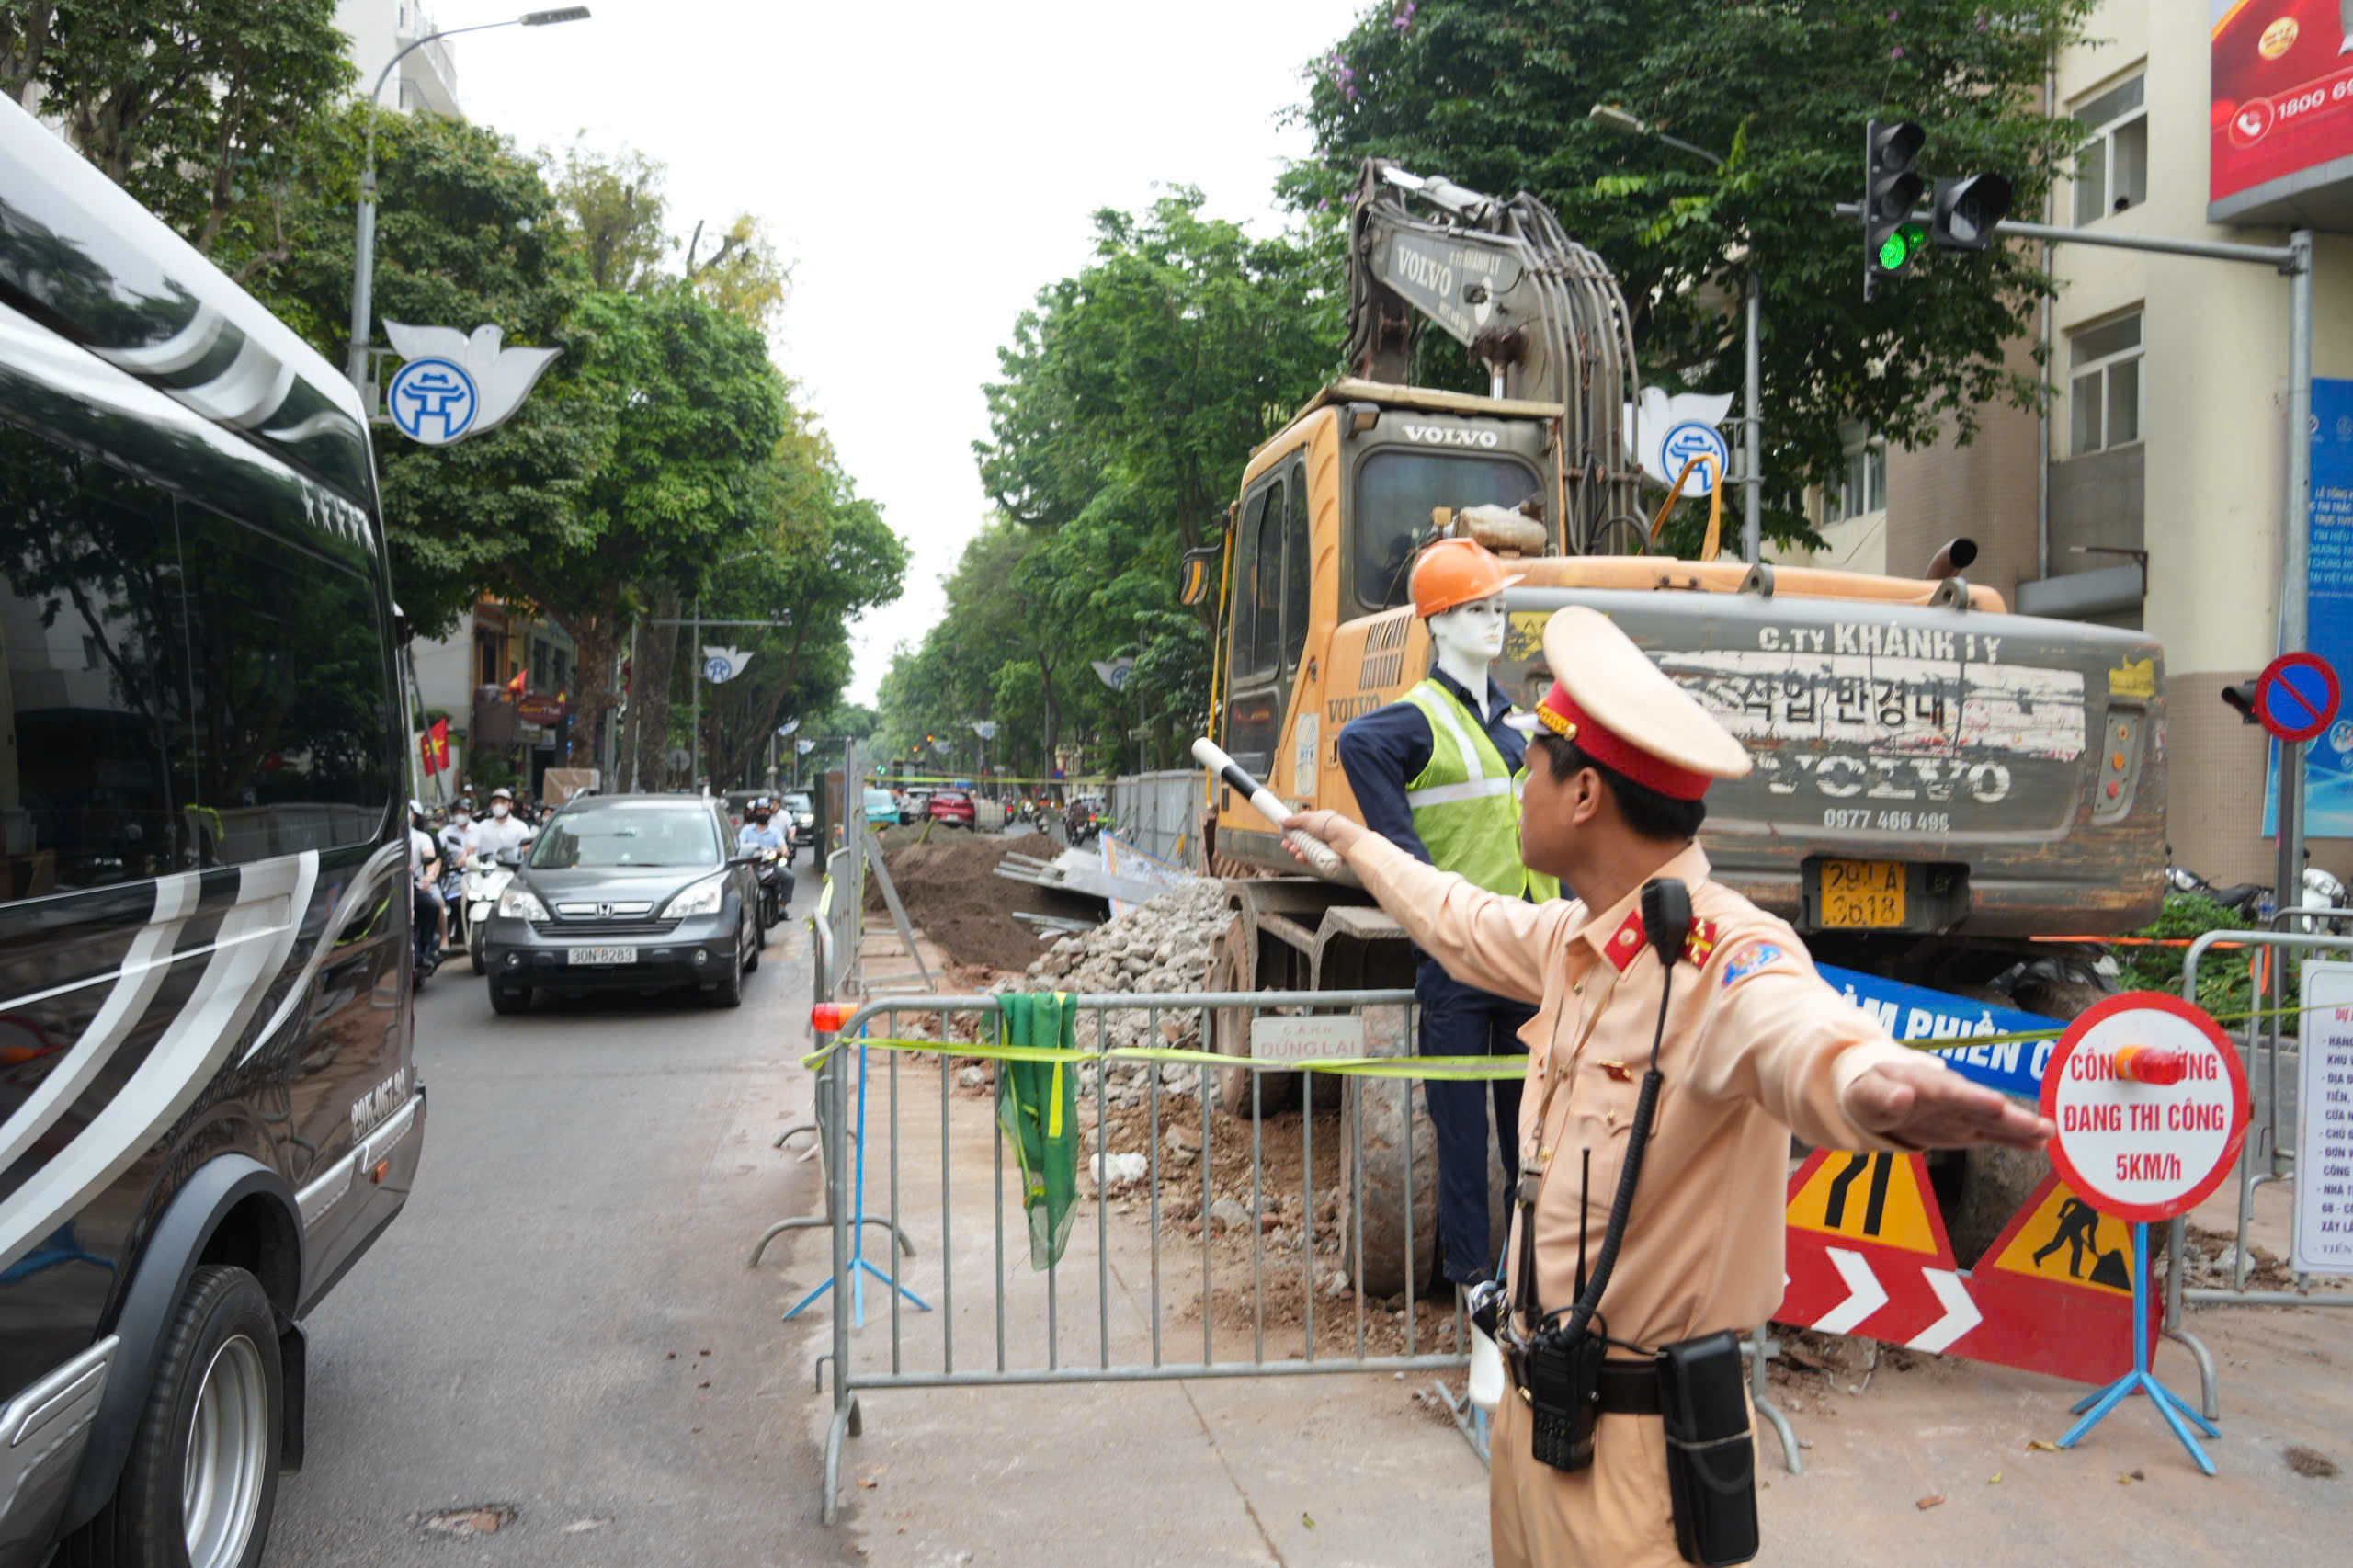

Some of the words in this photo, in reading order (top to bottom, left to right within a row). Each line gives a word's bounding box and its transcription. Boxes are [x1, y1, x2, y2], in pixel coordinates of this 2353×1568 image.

[2278, 88, 2325, 120] 1800
[1398, 244, 1452, 298] VOLVO
[1402, 425, 1497, 449] VOLVO
[1758, 626, 1825, 652] C.TY
[1824, 808, 1872, 829] 0977
[1877, 810, 1912, 831] 466
[2071, 1047, 2117, 1082] CÔN
[2327, 1053, 2347, 1066] KHU
[2063, 1103, 2122, 1131] ĐANG
[2129, 1103, 2161, 1131] THI
[2167, 1096, 2225, 1131] CÔNG
[2115, 1152, 2182, 1182] 5KM/h
